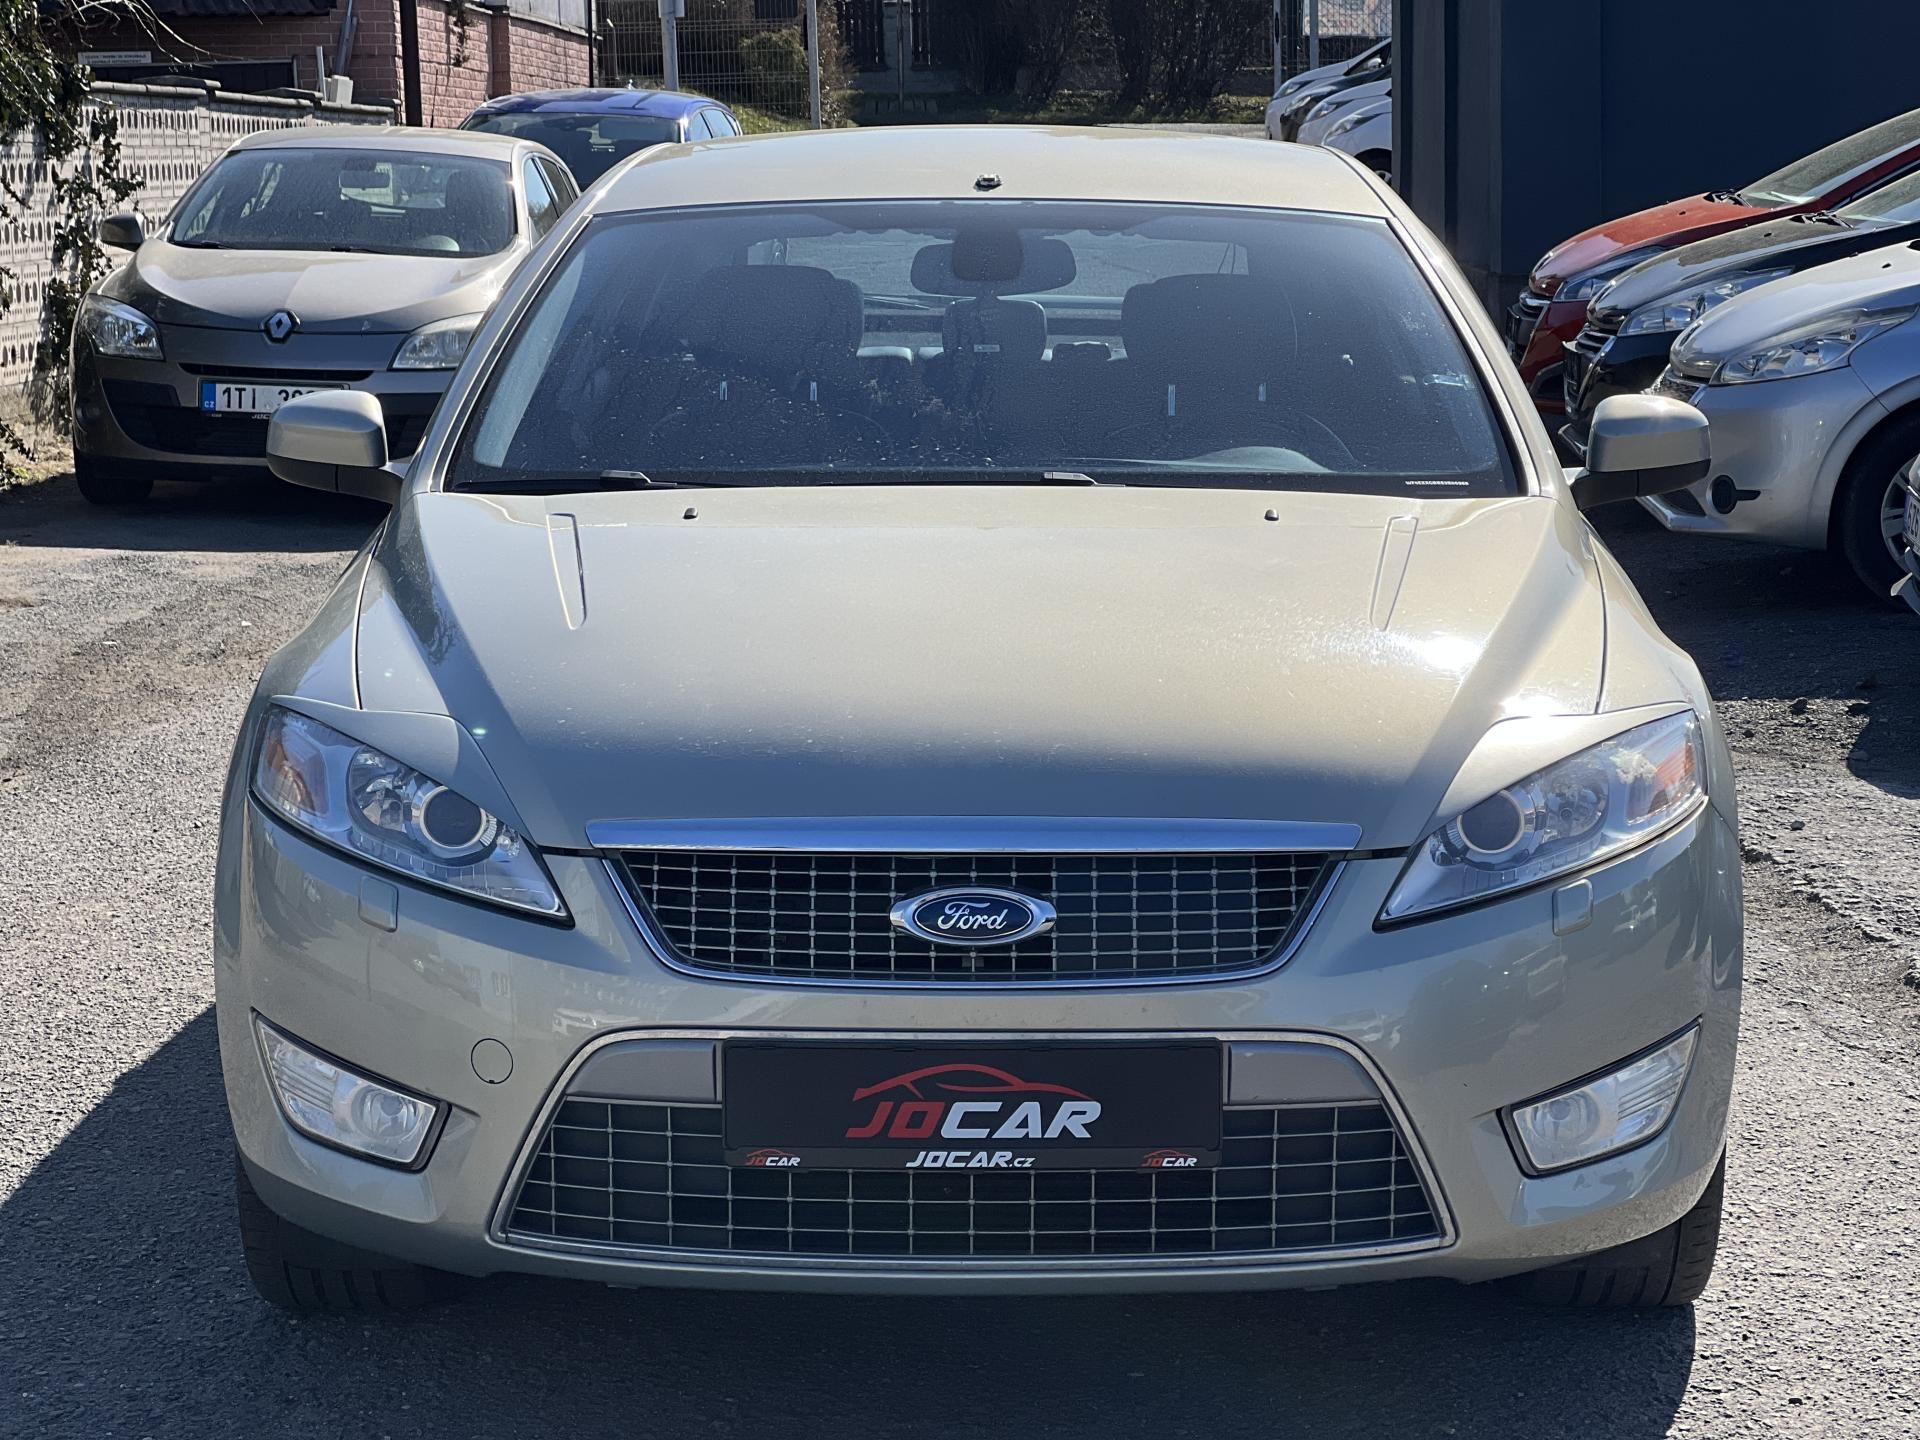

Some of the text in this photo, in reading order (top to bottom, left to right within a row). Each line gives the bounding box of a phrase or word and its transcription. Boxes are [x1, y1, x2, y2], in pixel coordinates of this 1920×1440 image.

[937, 901, 1009, 930] Ford
[845, 1101, 1102, 1139] JOCAR
[745, 1157, 801, 1167] JOCAR
[1141, 1157, 1198, 1167] JOCAR
